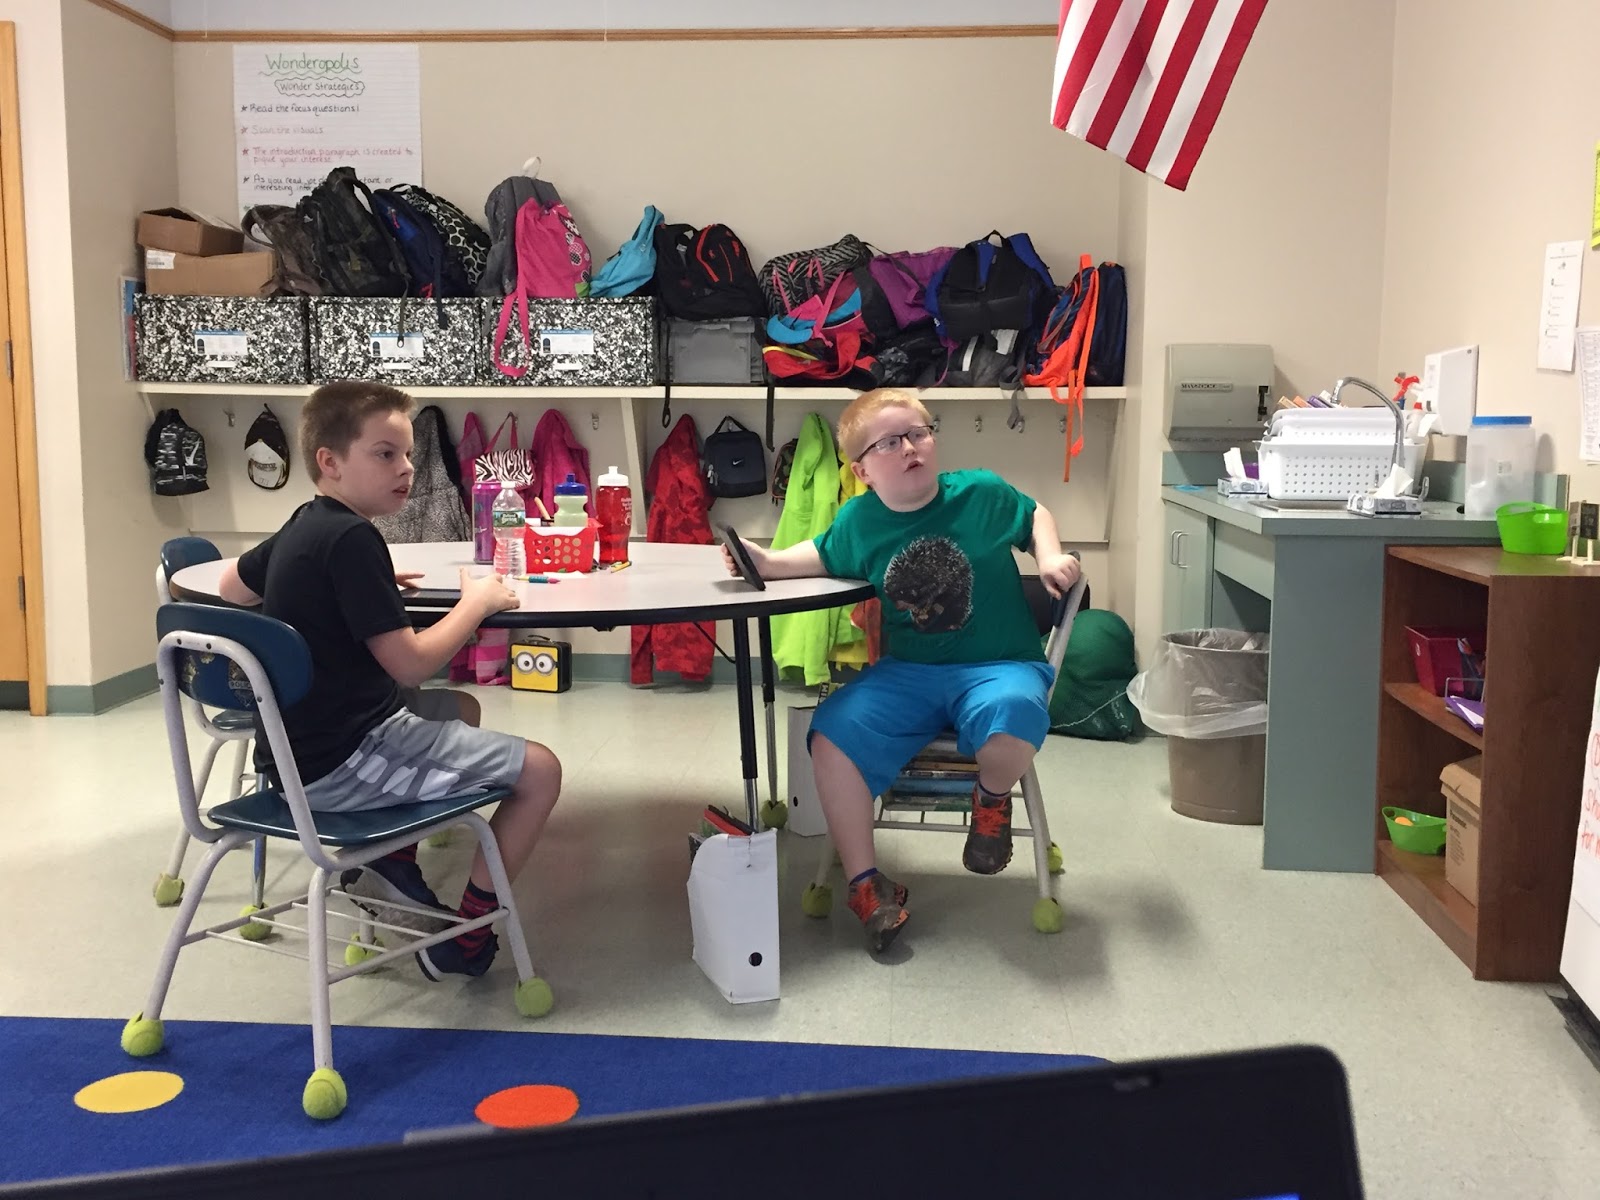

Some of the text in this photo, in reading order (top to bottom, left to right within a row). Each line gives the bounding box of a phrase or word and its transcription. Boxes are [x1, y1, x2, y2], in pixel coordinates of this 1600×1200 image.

[264, 52, 359, 73] Wonderopolis
[249, 103, 273, 114] Read
[275, 104, 289, 113] the
[291, 103, 311, 113] focus
[269, 146, 316, 156] introduction
[319, 147, 361, 159] paragraph
[372, 146, 403, 156] created
[253, 173, 266, 184] As
[267, 177, 283, 186] you
[253, 183, 294, 196] interesting
